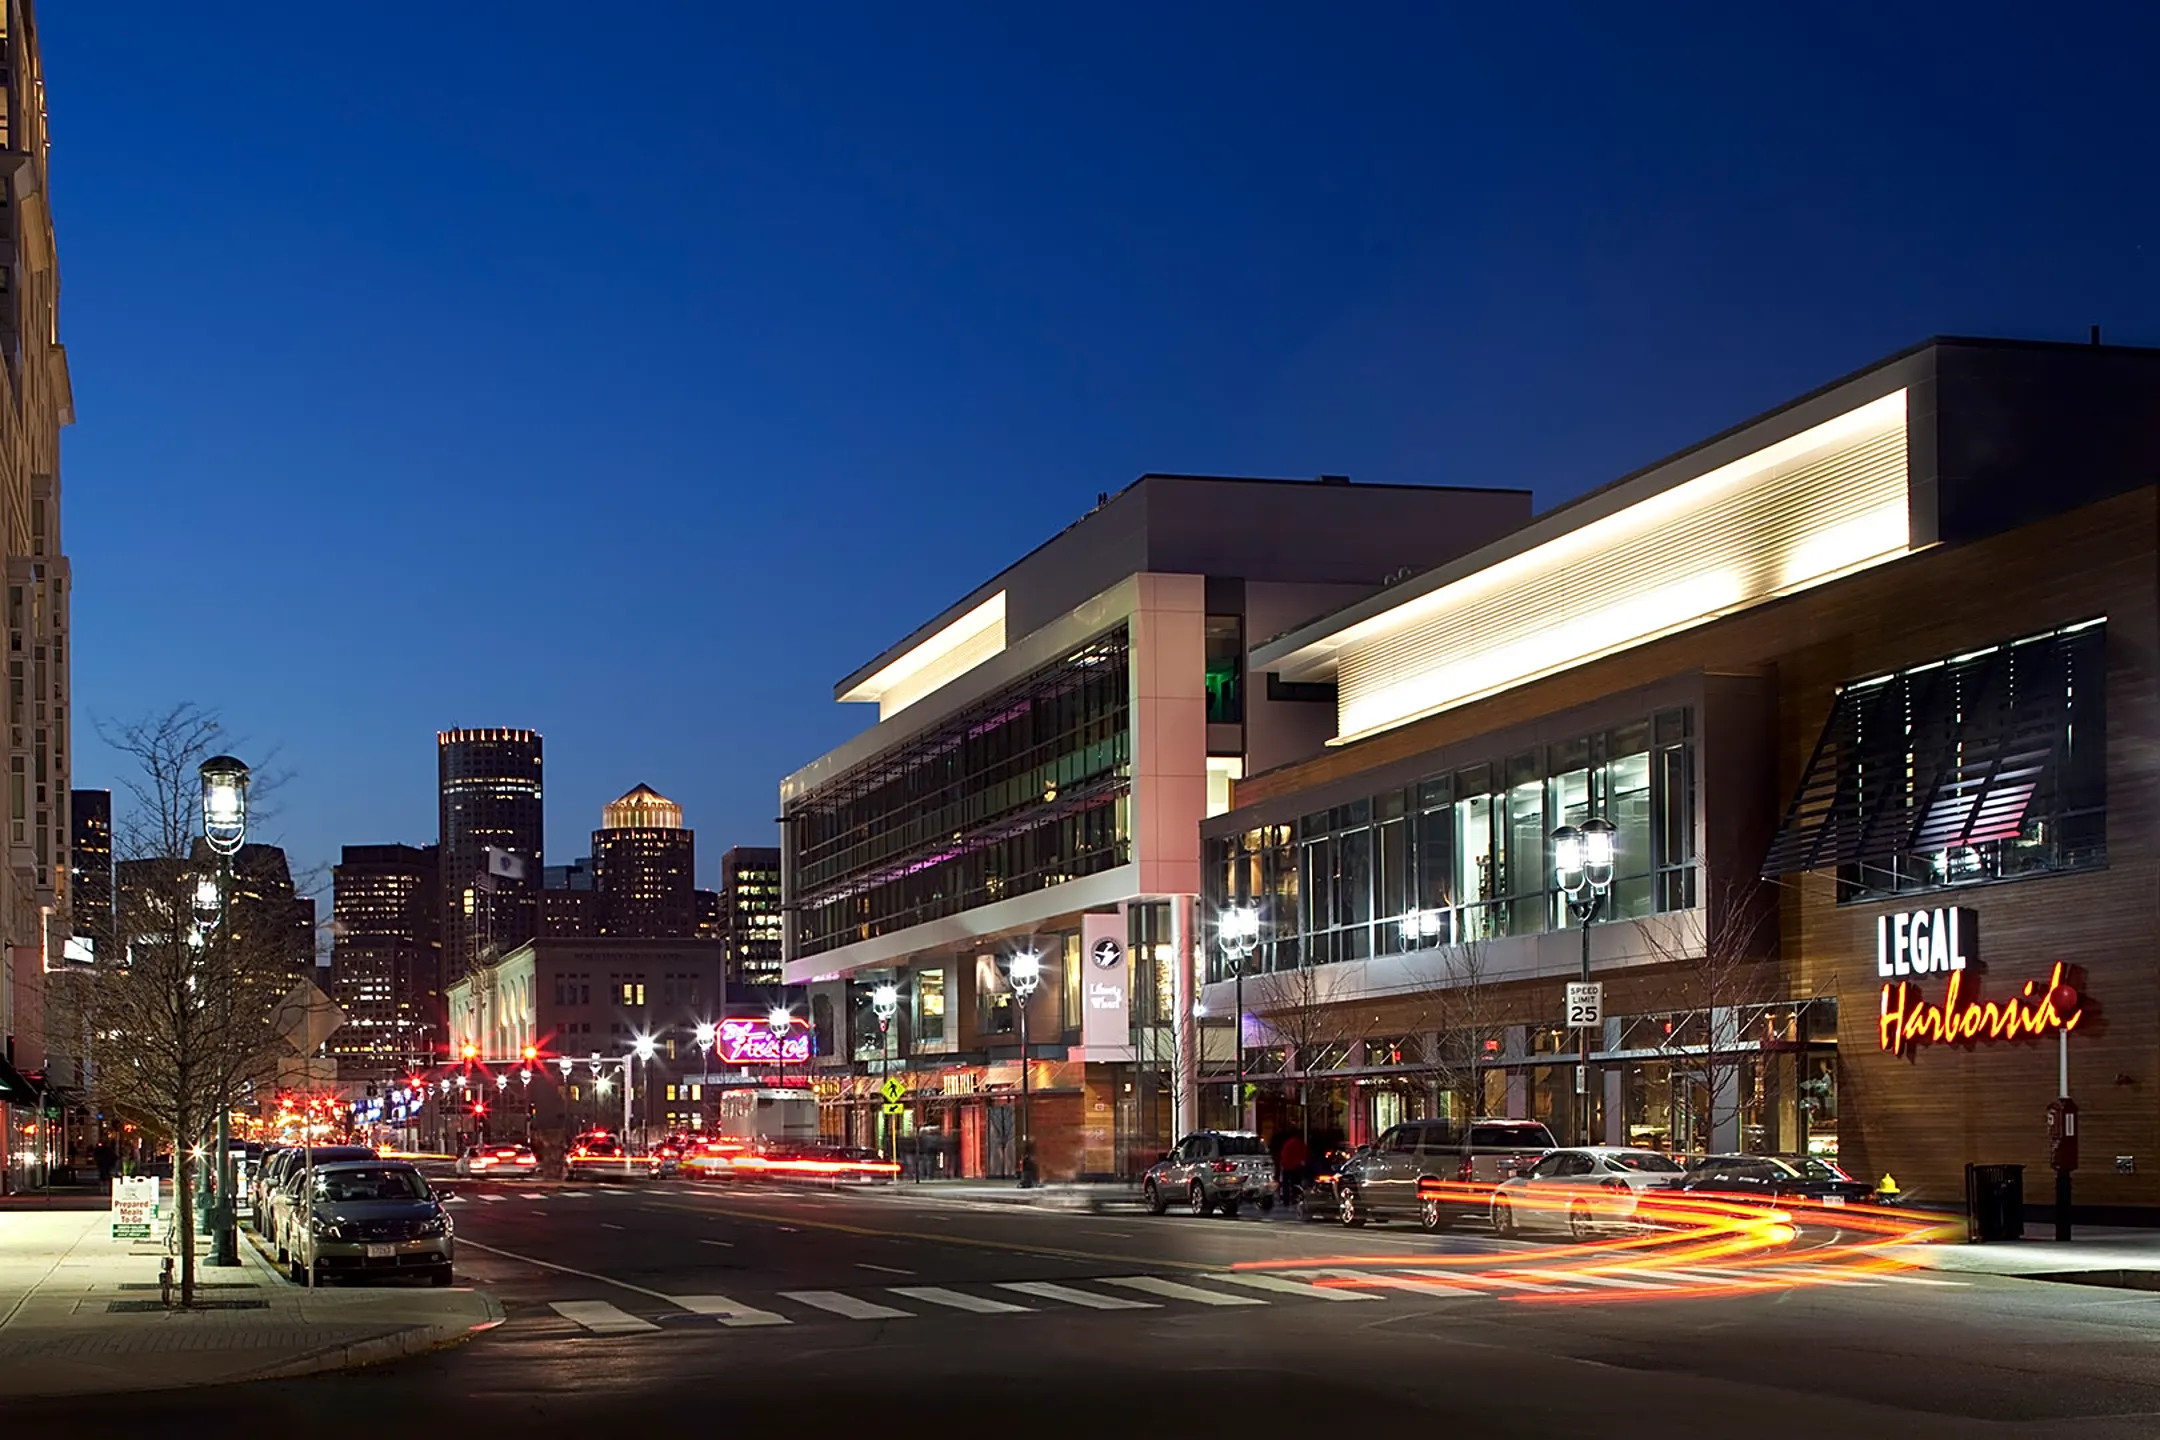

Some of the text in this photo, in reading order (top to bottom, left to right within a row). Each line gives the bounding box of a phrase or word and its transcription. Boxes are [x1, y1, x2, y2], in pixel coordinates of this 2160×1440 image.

[1878, 906, 1966, 977] LEGAL
[1570, 986, 1598, 995] SPEED
[1573, 996, 1596, 1004] LIMIT
[1571, 1006, 1597, 1022] 25
[115, 1200, 149, 1208] Prepared
